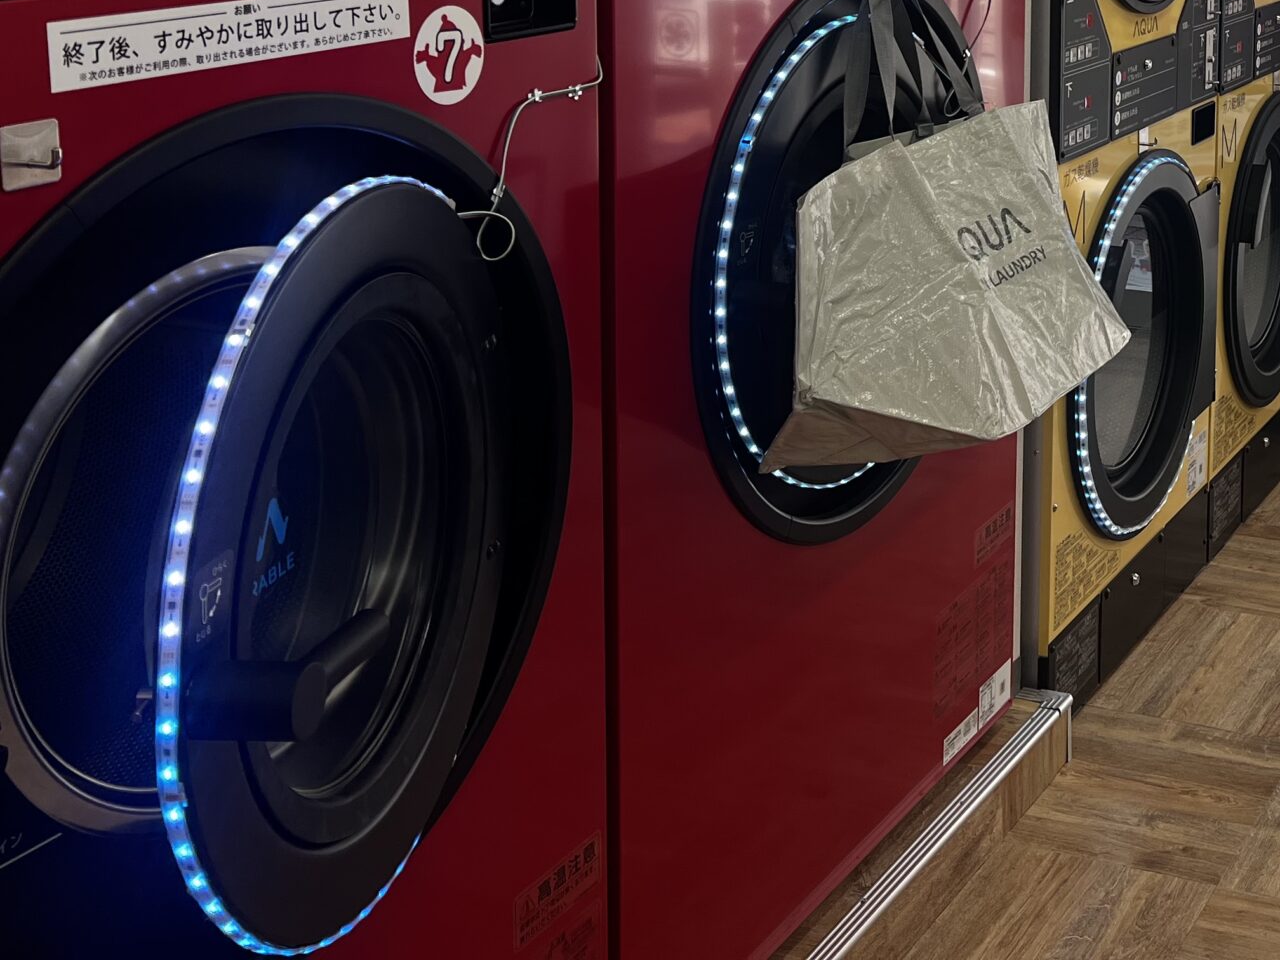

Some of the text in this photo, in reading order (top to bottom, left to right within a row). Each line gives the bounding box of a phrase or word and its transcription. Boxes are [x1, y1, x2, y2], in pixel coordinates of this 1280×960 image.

[234, 4, 261, 16] お願い
[1133, 16, 1159, 38] AQUA
[62, 4, 401, 68] 終了後、すみやかに取り出して下さい。
[436, 29, 463, 84] 7
[1065, 81, 1073, 98] 下
[1221, 118, 1237, 169] M
[1063, 157, 1099, 188] ガス乾燥機
[988, 245, 1046, 288] LAUNDRY
[537, 840, 598, 904] 高温注意
